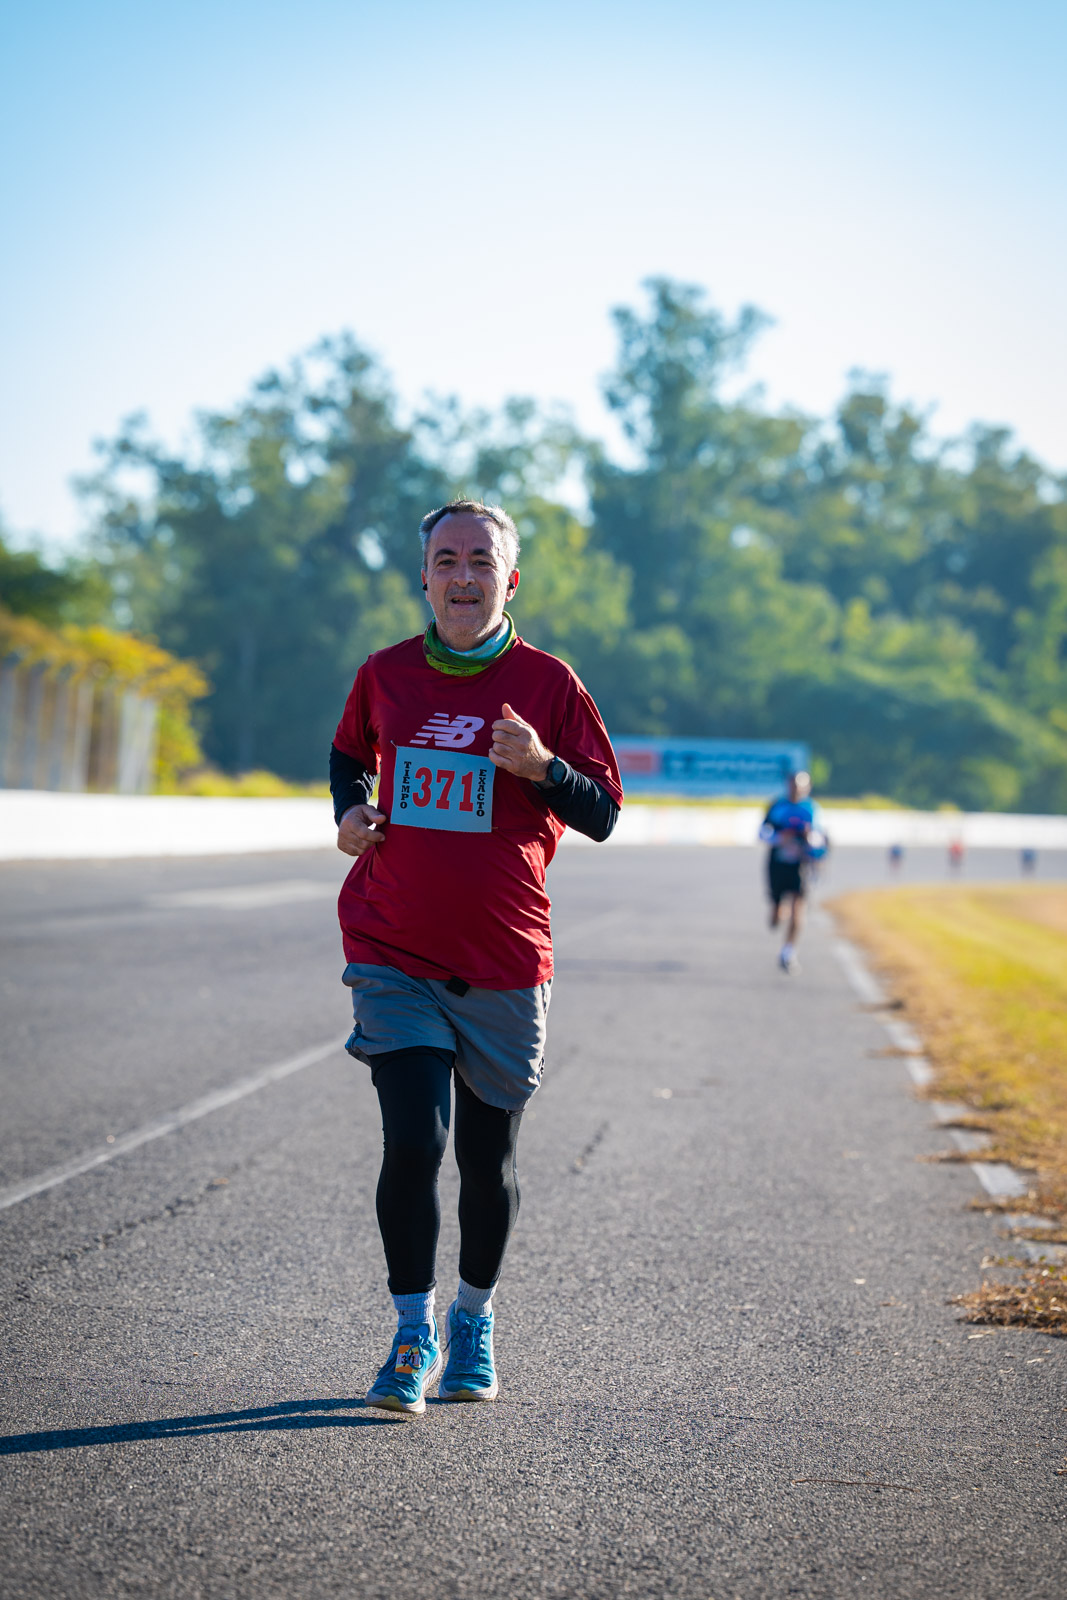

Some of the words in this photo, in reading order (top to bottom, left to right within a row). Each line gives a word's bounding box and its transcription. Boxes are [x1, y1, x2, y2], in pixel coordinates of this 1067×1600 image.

[409, 713, 485, 748] NB
[400, 761, 412, 809] TIEMPO
[412, 767, 474, 812] 371
[476, 769, 487, 817] EXACTO
